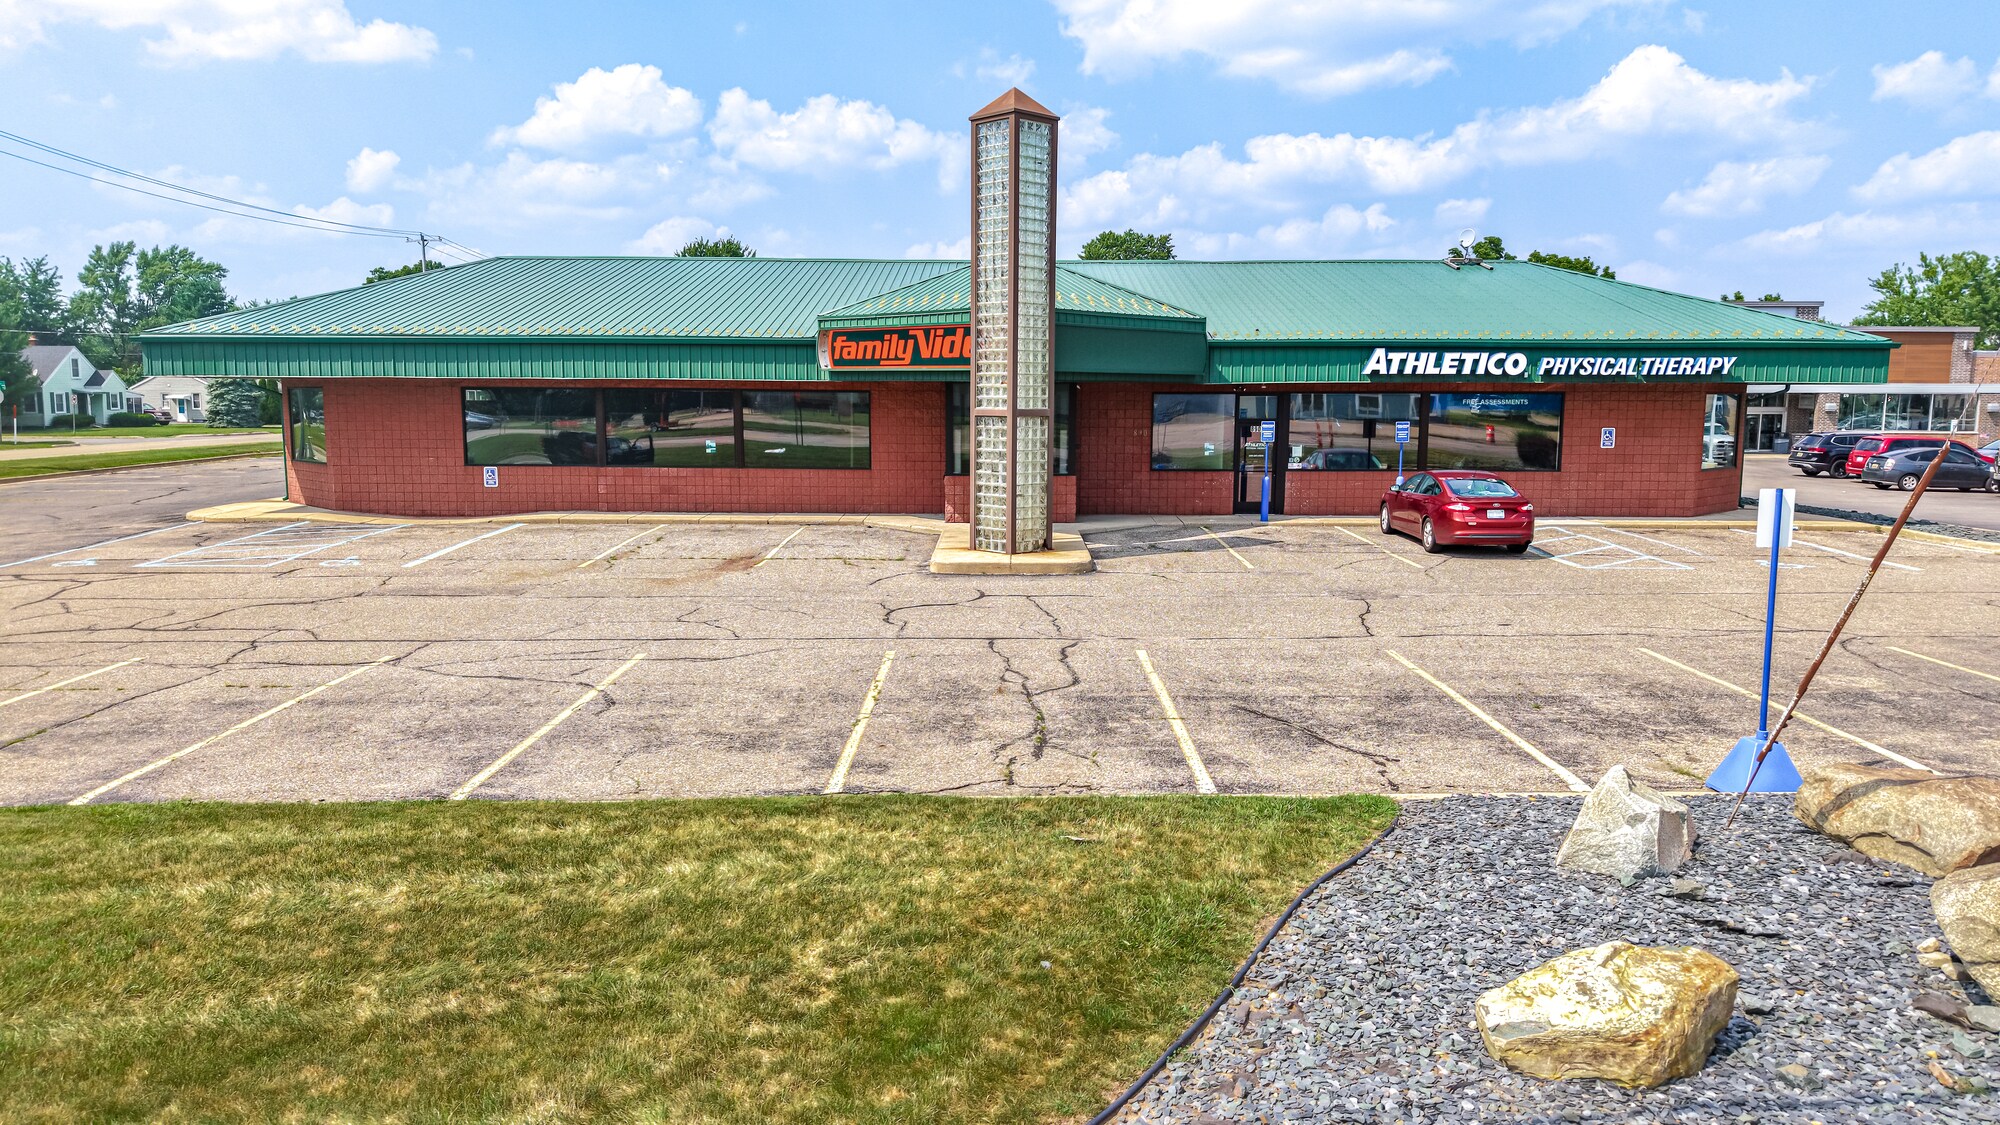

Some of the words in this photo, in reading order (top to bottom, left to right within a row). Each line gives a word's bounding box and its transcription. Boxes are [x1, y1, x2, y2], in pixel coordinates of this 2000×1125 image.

[833, 334, 914, 365] family
[1361, 348, 1528, 376] ATHLETICO
[1538, 357, 1638, 376] PHYSICAL
[1639, 356, 1738, 376] THERAPY
[1462, 398, 1479, 406] FREE
[1480, 398, 1529, 406] ASSESSMENTS
